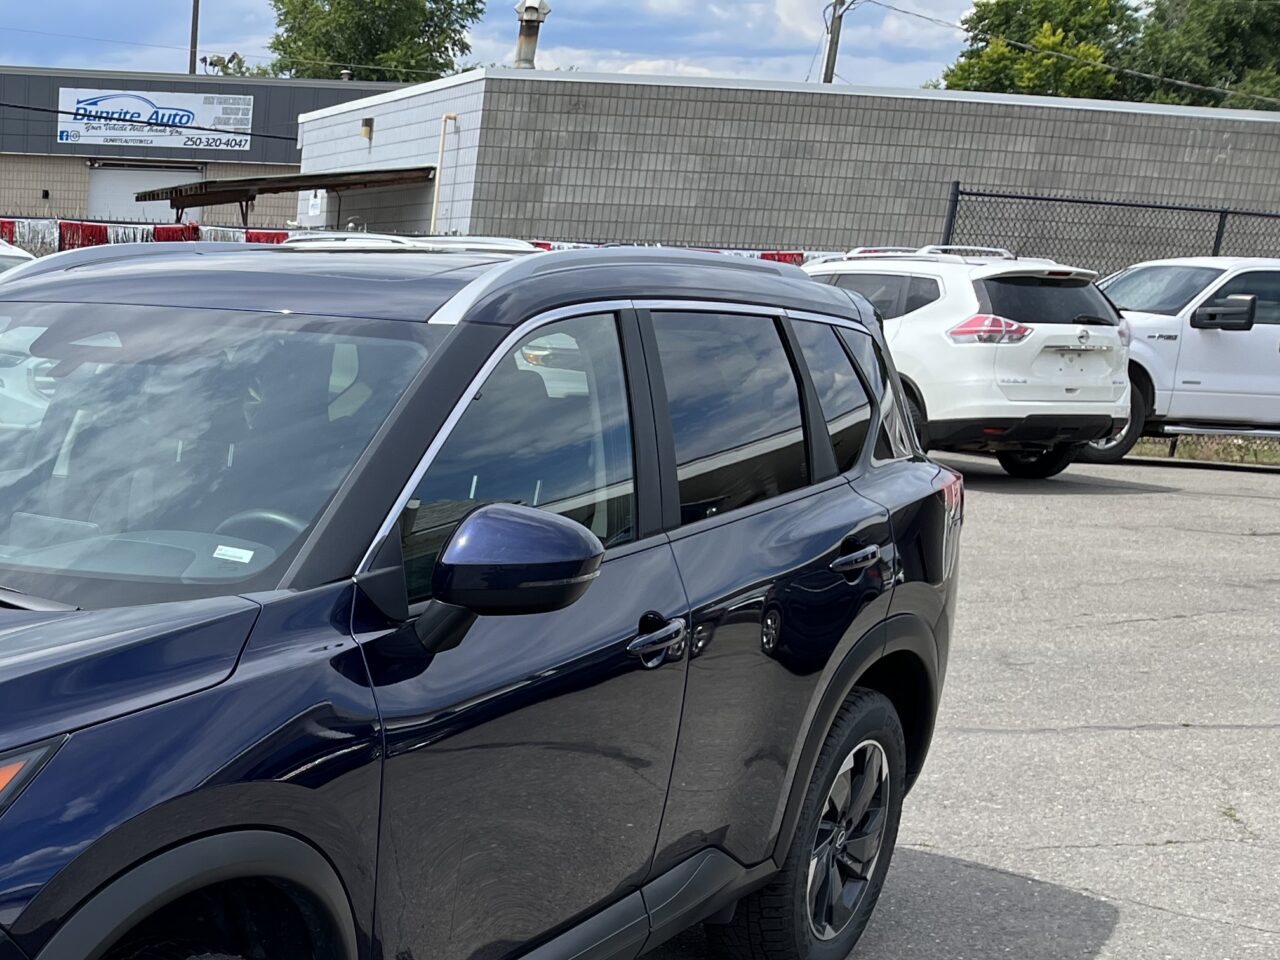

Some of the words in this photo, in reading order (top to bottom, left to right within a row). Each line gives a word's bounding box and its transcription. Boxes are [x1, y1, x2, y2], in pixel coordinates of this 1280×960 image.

[73, 107, 141, 122] Dunrite
[147, 109, 191, 127] Auto
[183, 137, 249, 148] 250-320-4047
